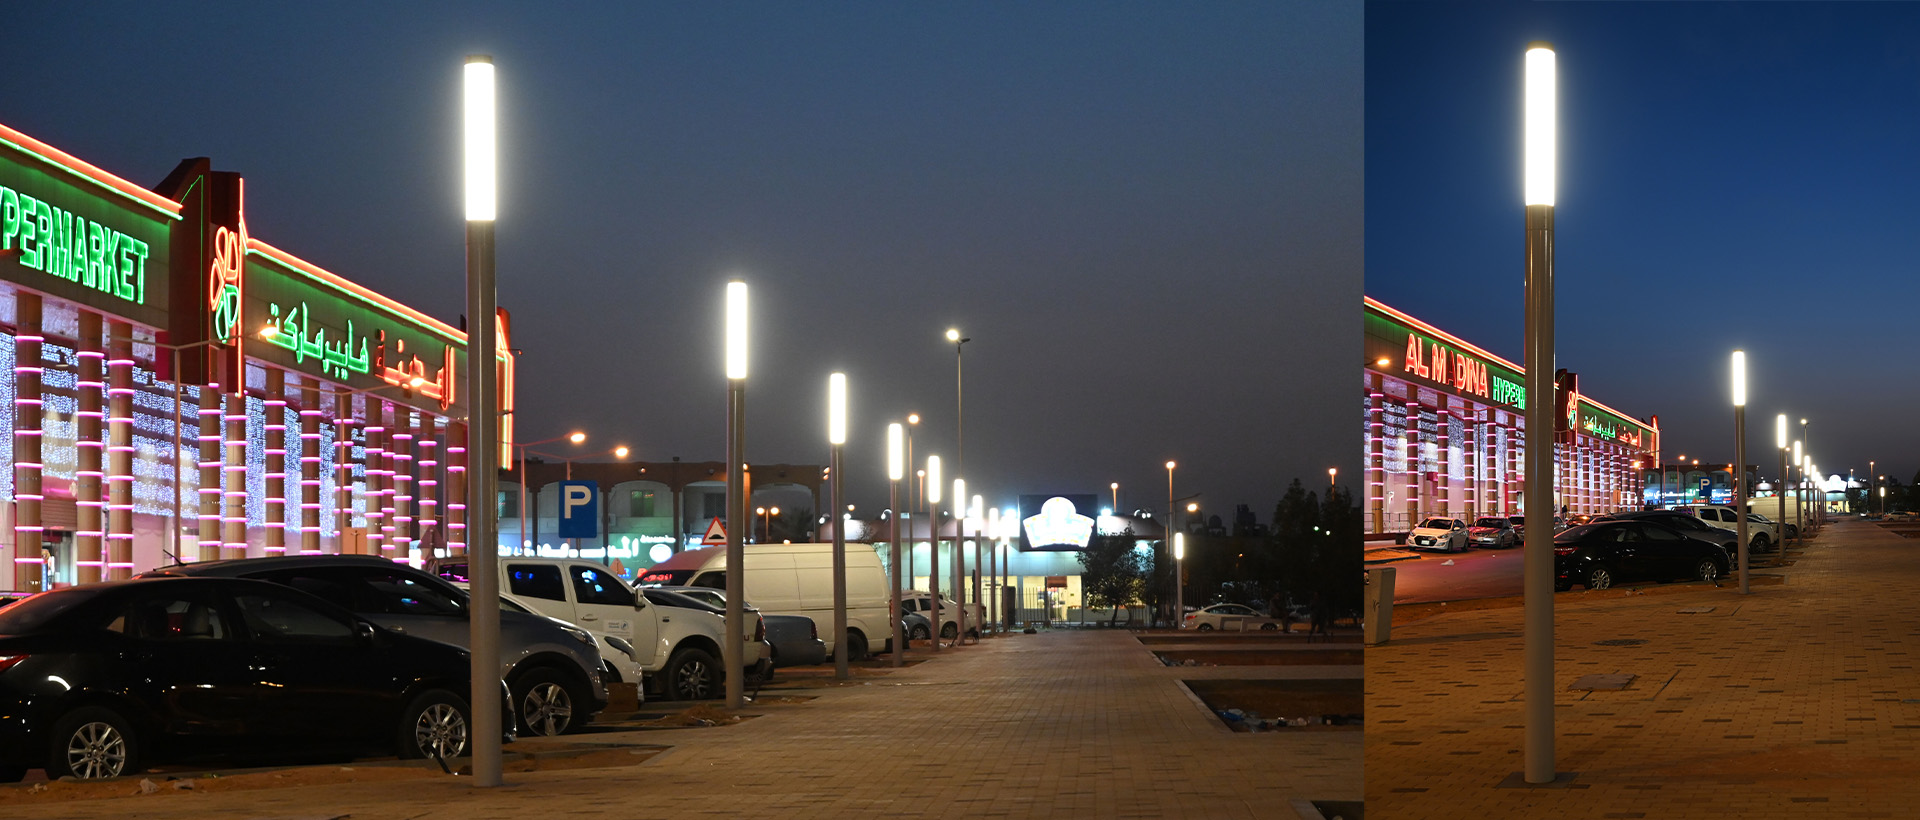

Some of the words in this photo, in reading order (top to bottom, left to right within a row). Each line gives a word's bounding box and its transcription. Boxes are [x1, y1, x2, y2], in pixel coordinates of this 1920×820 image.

[0, 185, 149, 305] PERMARKET
[1404, 333, 1429, 379] AL
[1432, 343, 1489, 399] MADINA
[564, 485, 592, 519] P
[1700, 478, 1711, 491] P
